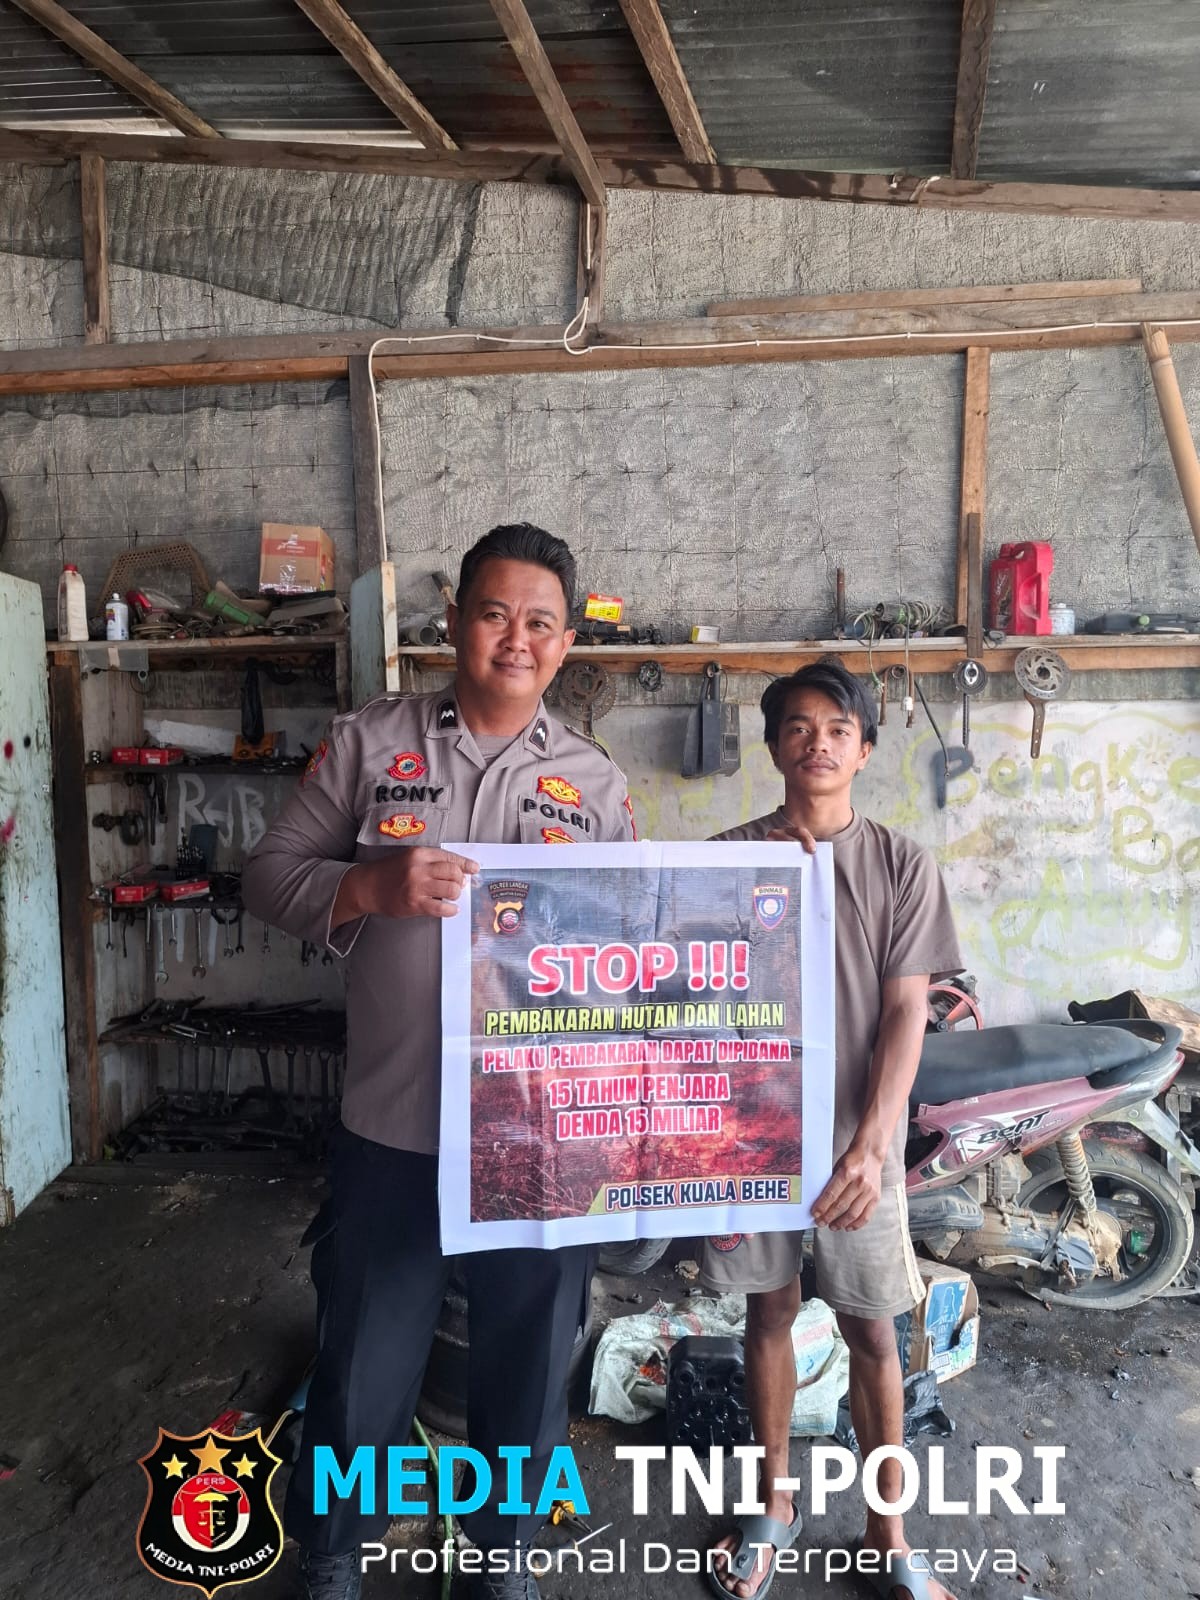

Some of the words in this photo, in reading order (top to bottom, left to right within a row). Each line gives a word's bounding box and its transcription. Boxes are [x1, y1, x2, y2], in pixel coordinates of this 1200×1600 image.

[376, 785, 444, 803] RONY
[523, 798, 591, 833] POLRI
[528, 942, 678, 996] STOP
[688, 941, 750, 991] !!!
[485, 1008, 615, 1035] PEMBAKARAN
[621, 1004, 678, 1031] HUTAN
[684, 1003, 720, 1028] DAN
[726, 1002, 785, 1027] LAHAN
[482, 1046, 546, 1073] PELAKU
[550, 1042, 658, 1068] PEMBAKARAN
[660, 1040, 714, 1064] DAPAT
[717, 1039, 791, 1061] DIPIDANA
[548, 1080, 573, 1107] 15
[576, 1076, 638, 1105] TAHUN
[642, 1073, 730, 1102] PENJARA
[556, 1109, 622, 1141] DENDA
[626, 1107, 649, 1135] 15
[651, 1106, 721, 1134] MILIAR
[606, 1184, 676, 1211] POLSEK
[680, 1181, 737, 1207] KUALA
[741, 1178, 789, 1203] BEHE
